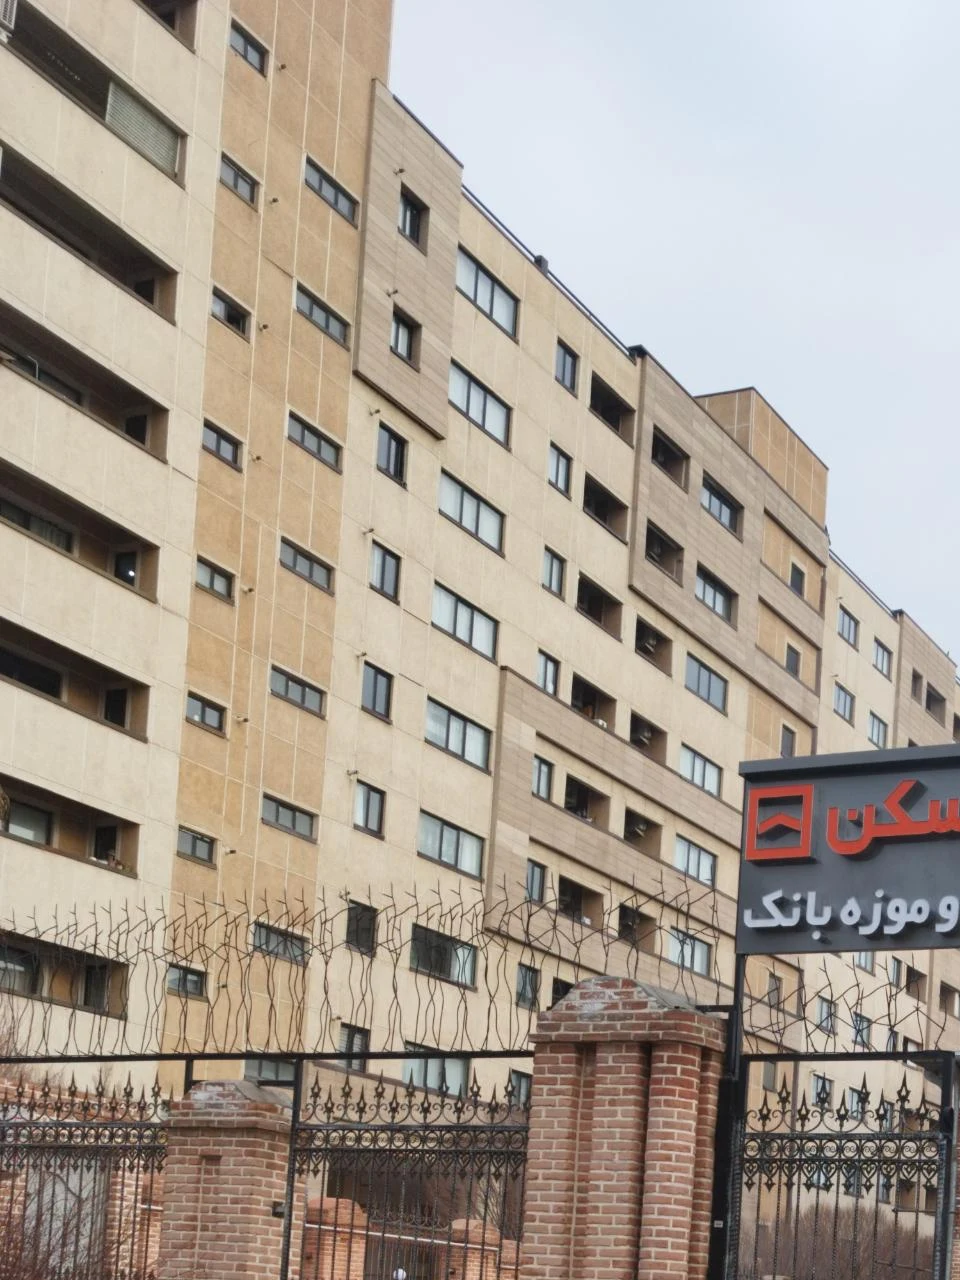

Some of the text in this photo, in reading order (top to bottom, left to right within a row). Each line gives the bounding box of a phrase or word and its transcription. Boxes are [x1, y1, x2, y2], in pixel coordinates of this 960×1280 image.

[743, 889, 832, 941] بانک
[840, 889, 930, 936] موزه
[935, 892, 960, 933] و
